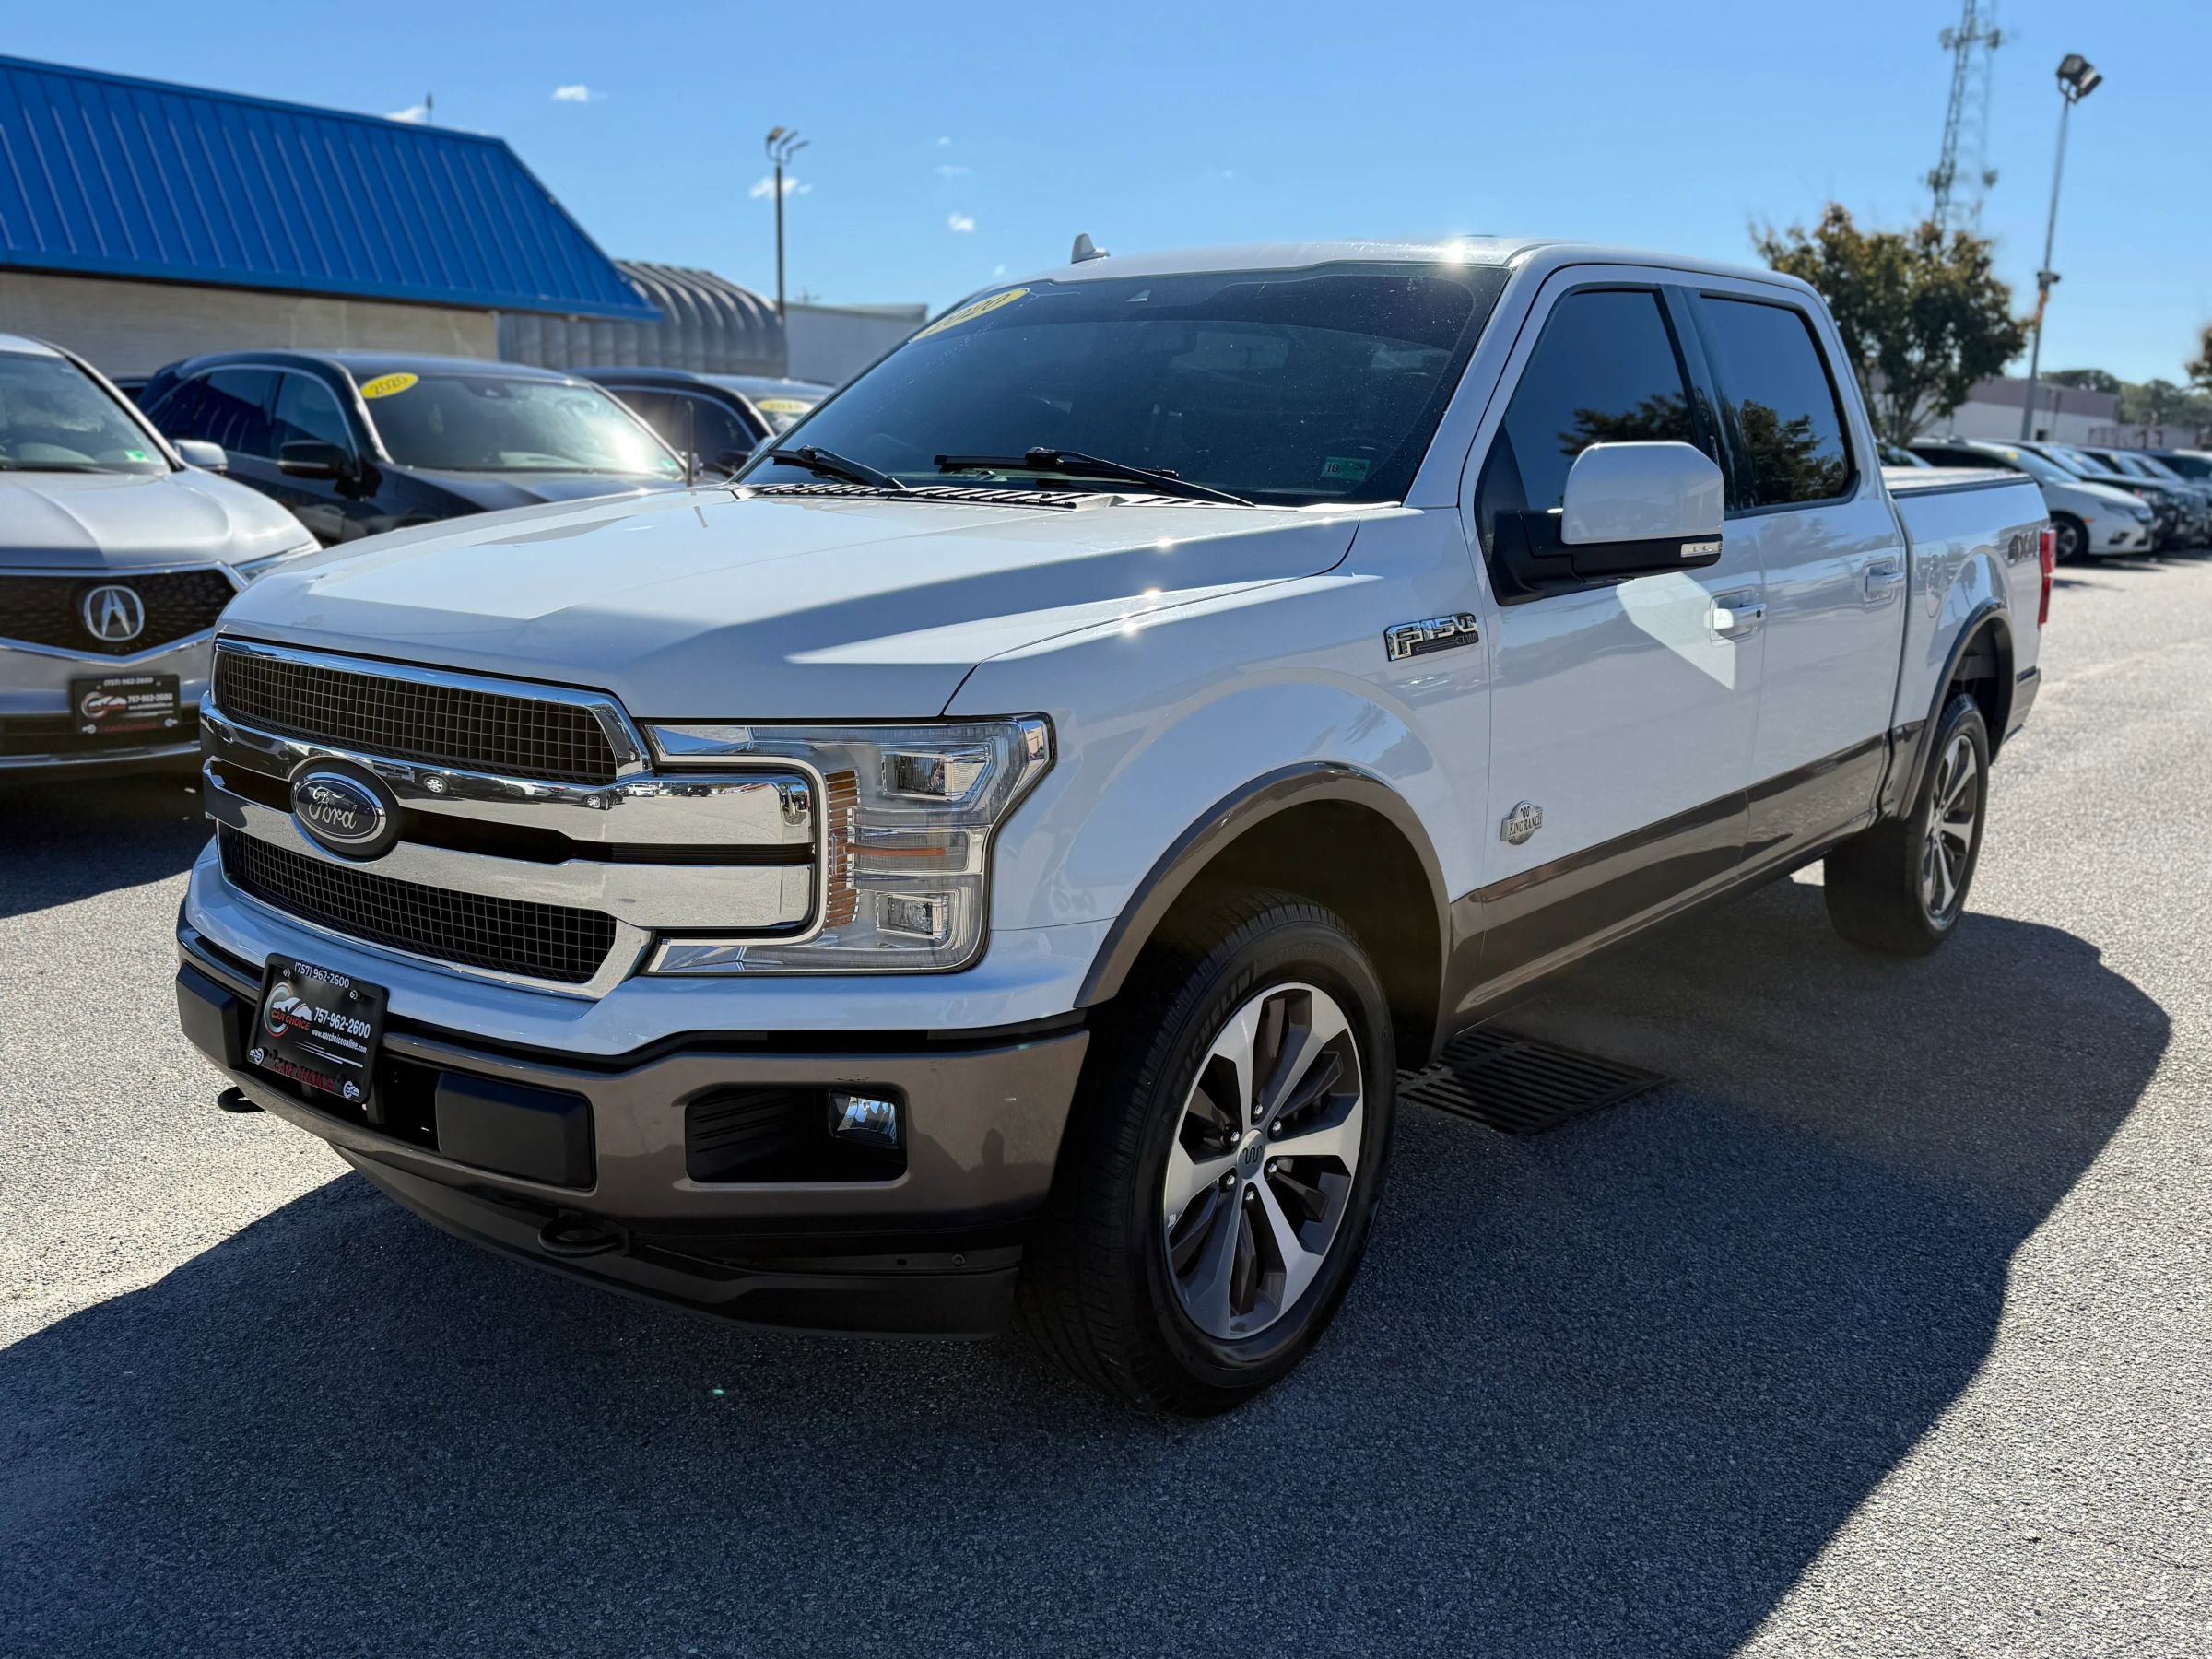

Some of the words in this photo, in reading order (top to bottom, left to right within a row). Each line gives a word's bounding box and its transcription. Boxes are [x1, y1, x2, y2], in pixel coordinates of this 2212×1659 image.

[370, 376, 407, 394] 2020
[1327, 464, 1339, 473] 10
[2008, 532, 2037, 561] 4X4
[308, 785, 357, 830] Ford
[1510, 820, 1523, 835] KING
[1524, 812, 1542, 830] RANCH
[294, 962, 312, 978] (757)
[313, 967, 350, 989] 962-2600
[271, 1010, 285, 1021] CAR
[285, 1015, 311, 1030] CHOICE
[313, 1006, 371, 1039] 757-962-2600
[312, 1029, 367, 1053] www.carchoiceonline.com
